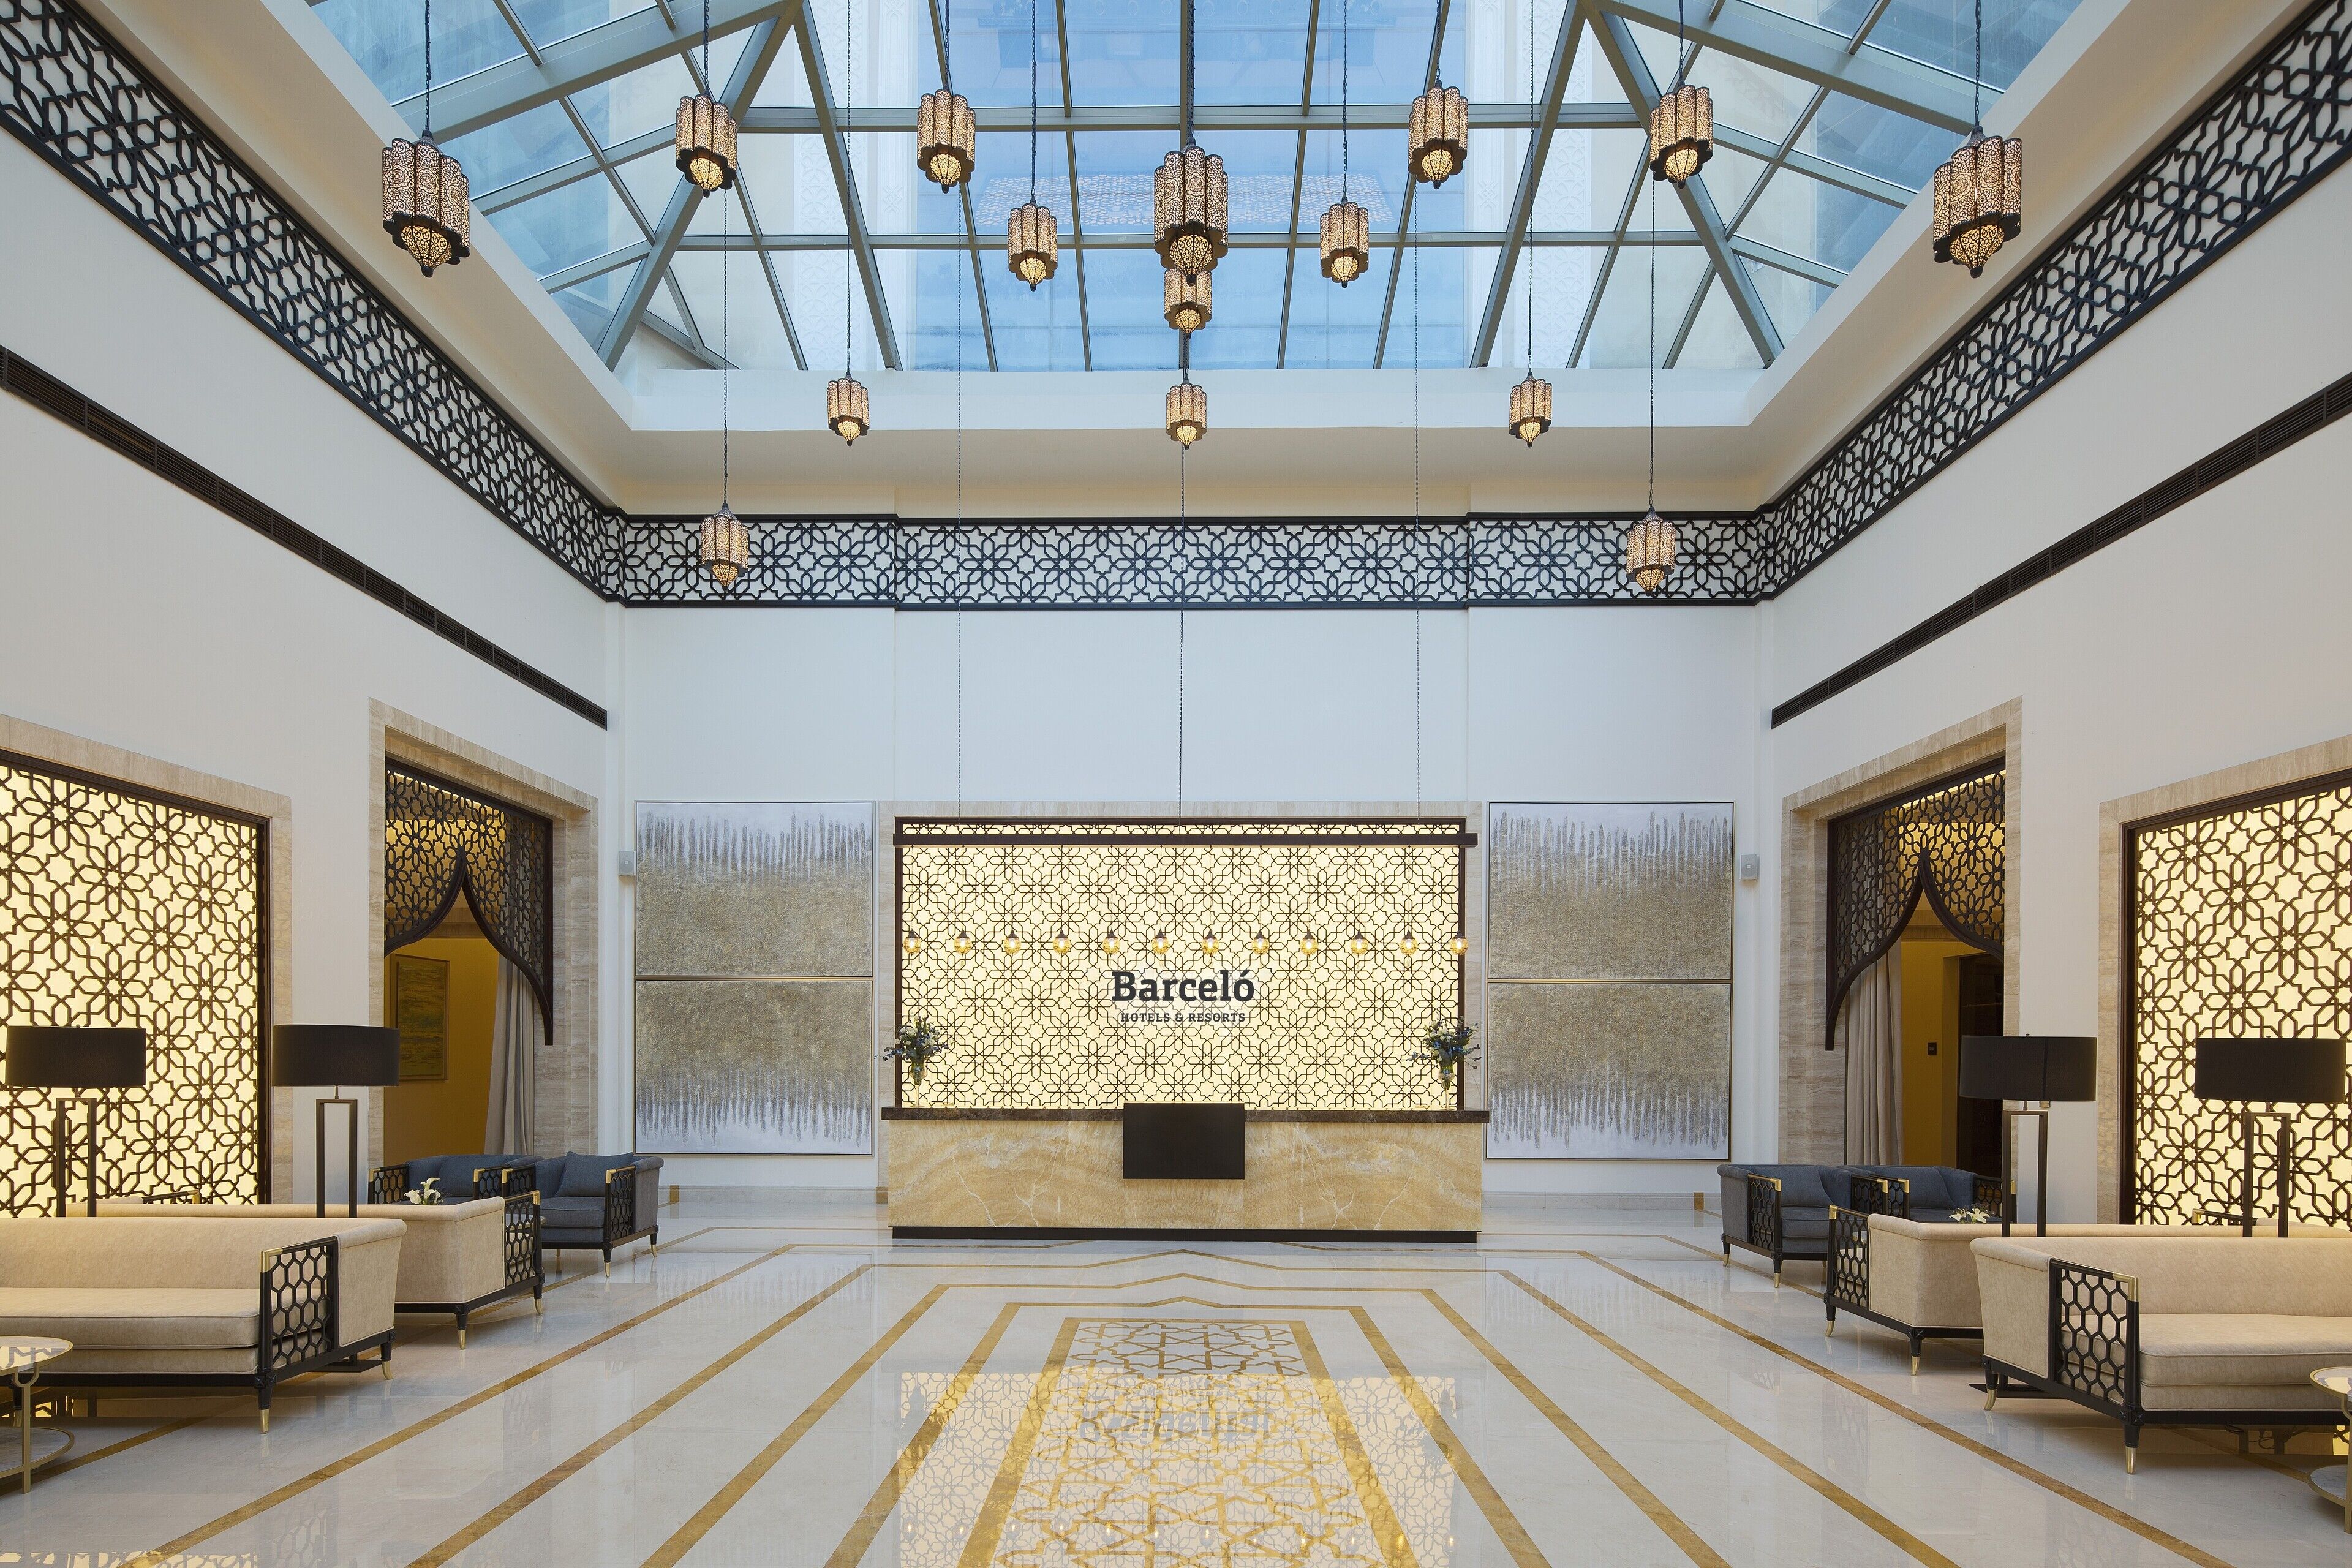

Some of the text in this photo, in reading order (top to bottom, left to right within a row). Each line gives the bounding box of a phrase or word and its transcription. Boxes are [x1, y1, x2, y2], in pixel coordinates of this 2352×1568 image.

[1112, 970, 1254, 1001] Barceló
[1121, 1013, 1245, 1022] HOTELS & RESORTS
